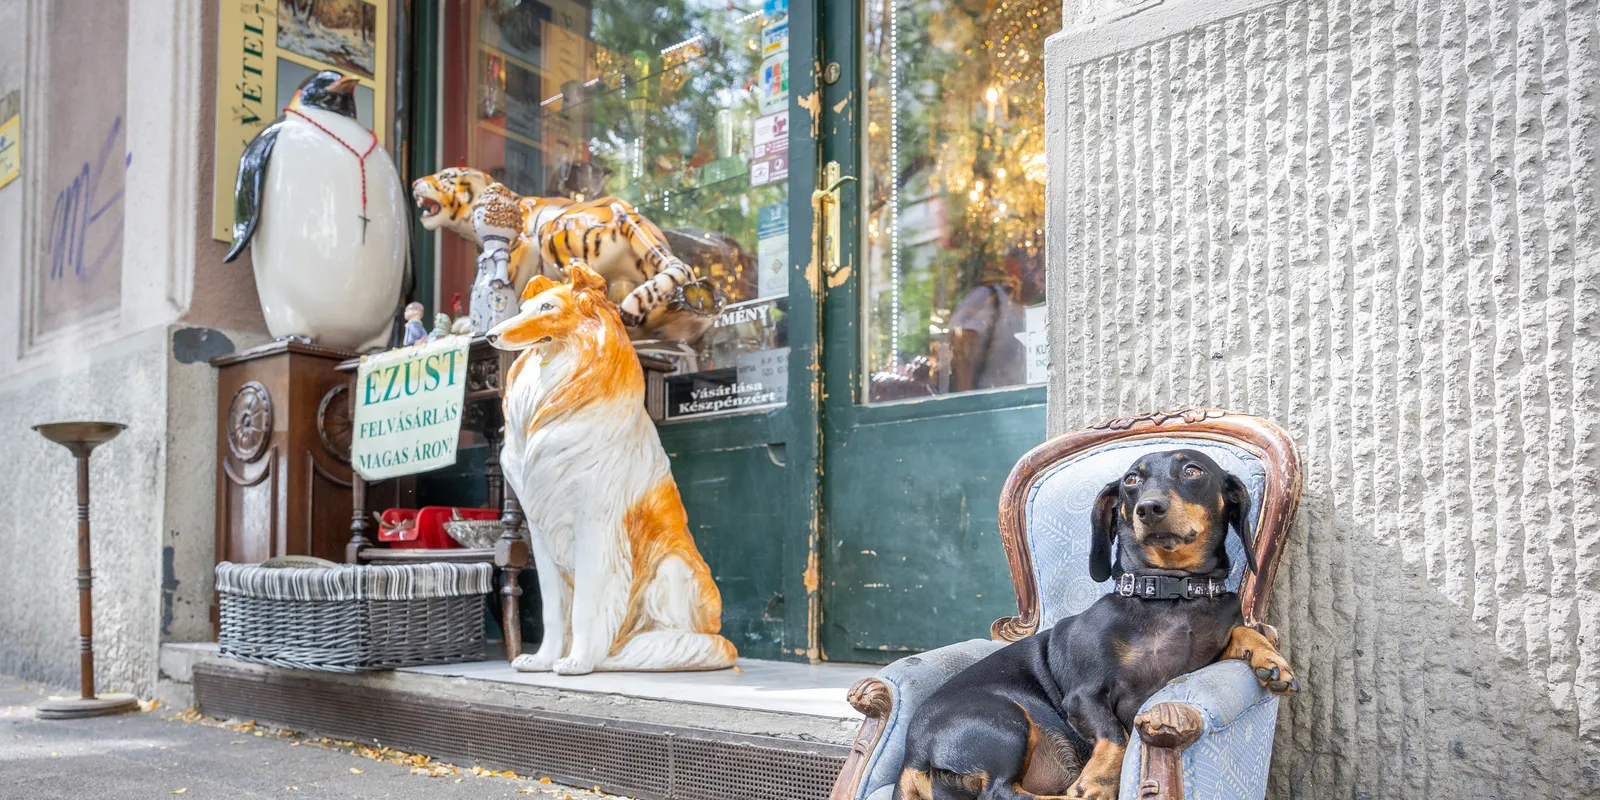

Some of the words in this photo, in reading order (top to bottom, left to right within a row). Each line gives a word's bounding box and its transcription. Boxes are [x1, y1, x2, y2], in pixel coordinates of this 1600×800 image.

[236, 0, 265, 125] VÉTEL-
[360, 400, 459, 439] FELVÁSÁRLÁS
[679, 391, 776, 413] Készpénzért
[359, 447, 410, 470] MAGAS
[412, 437, 454, 463] ÁRON!
